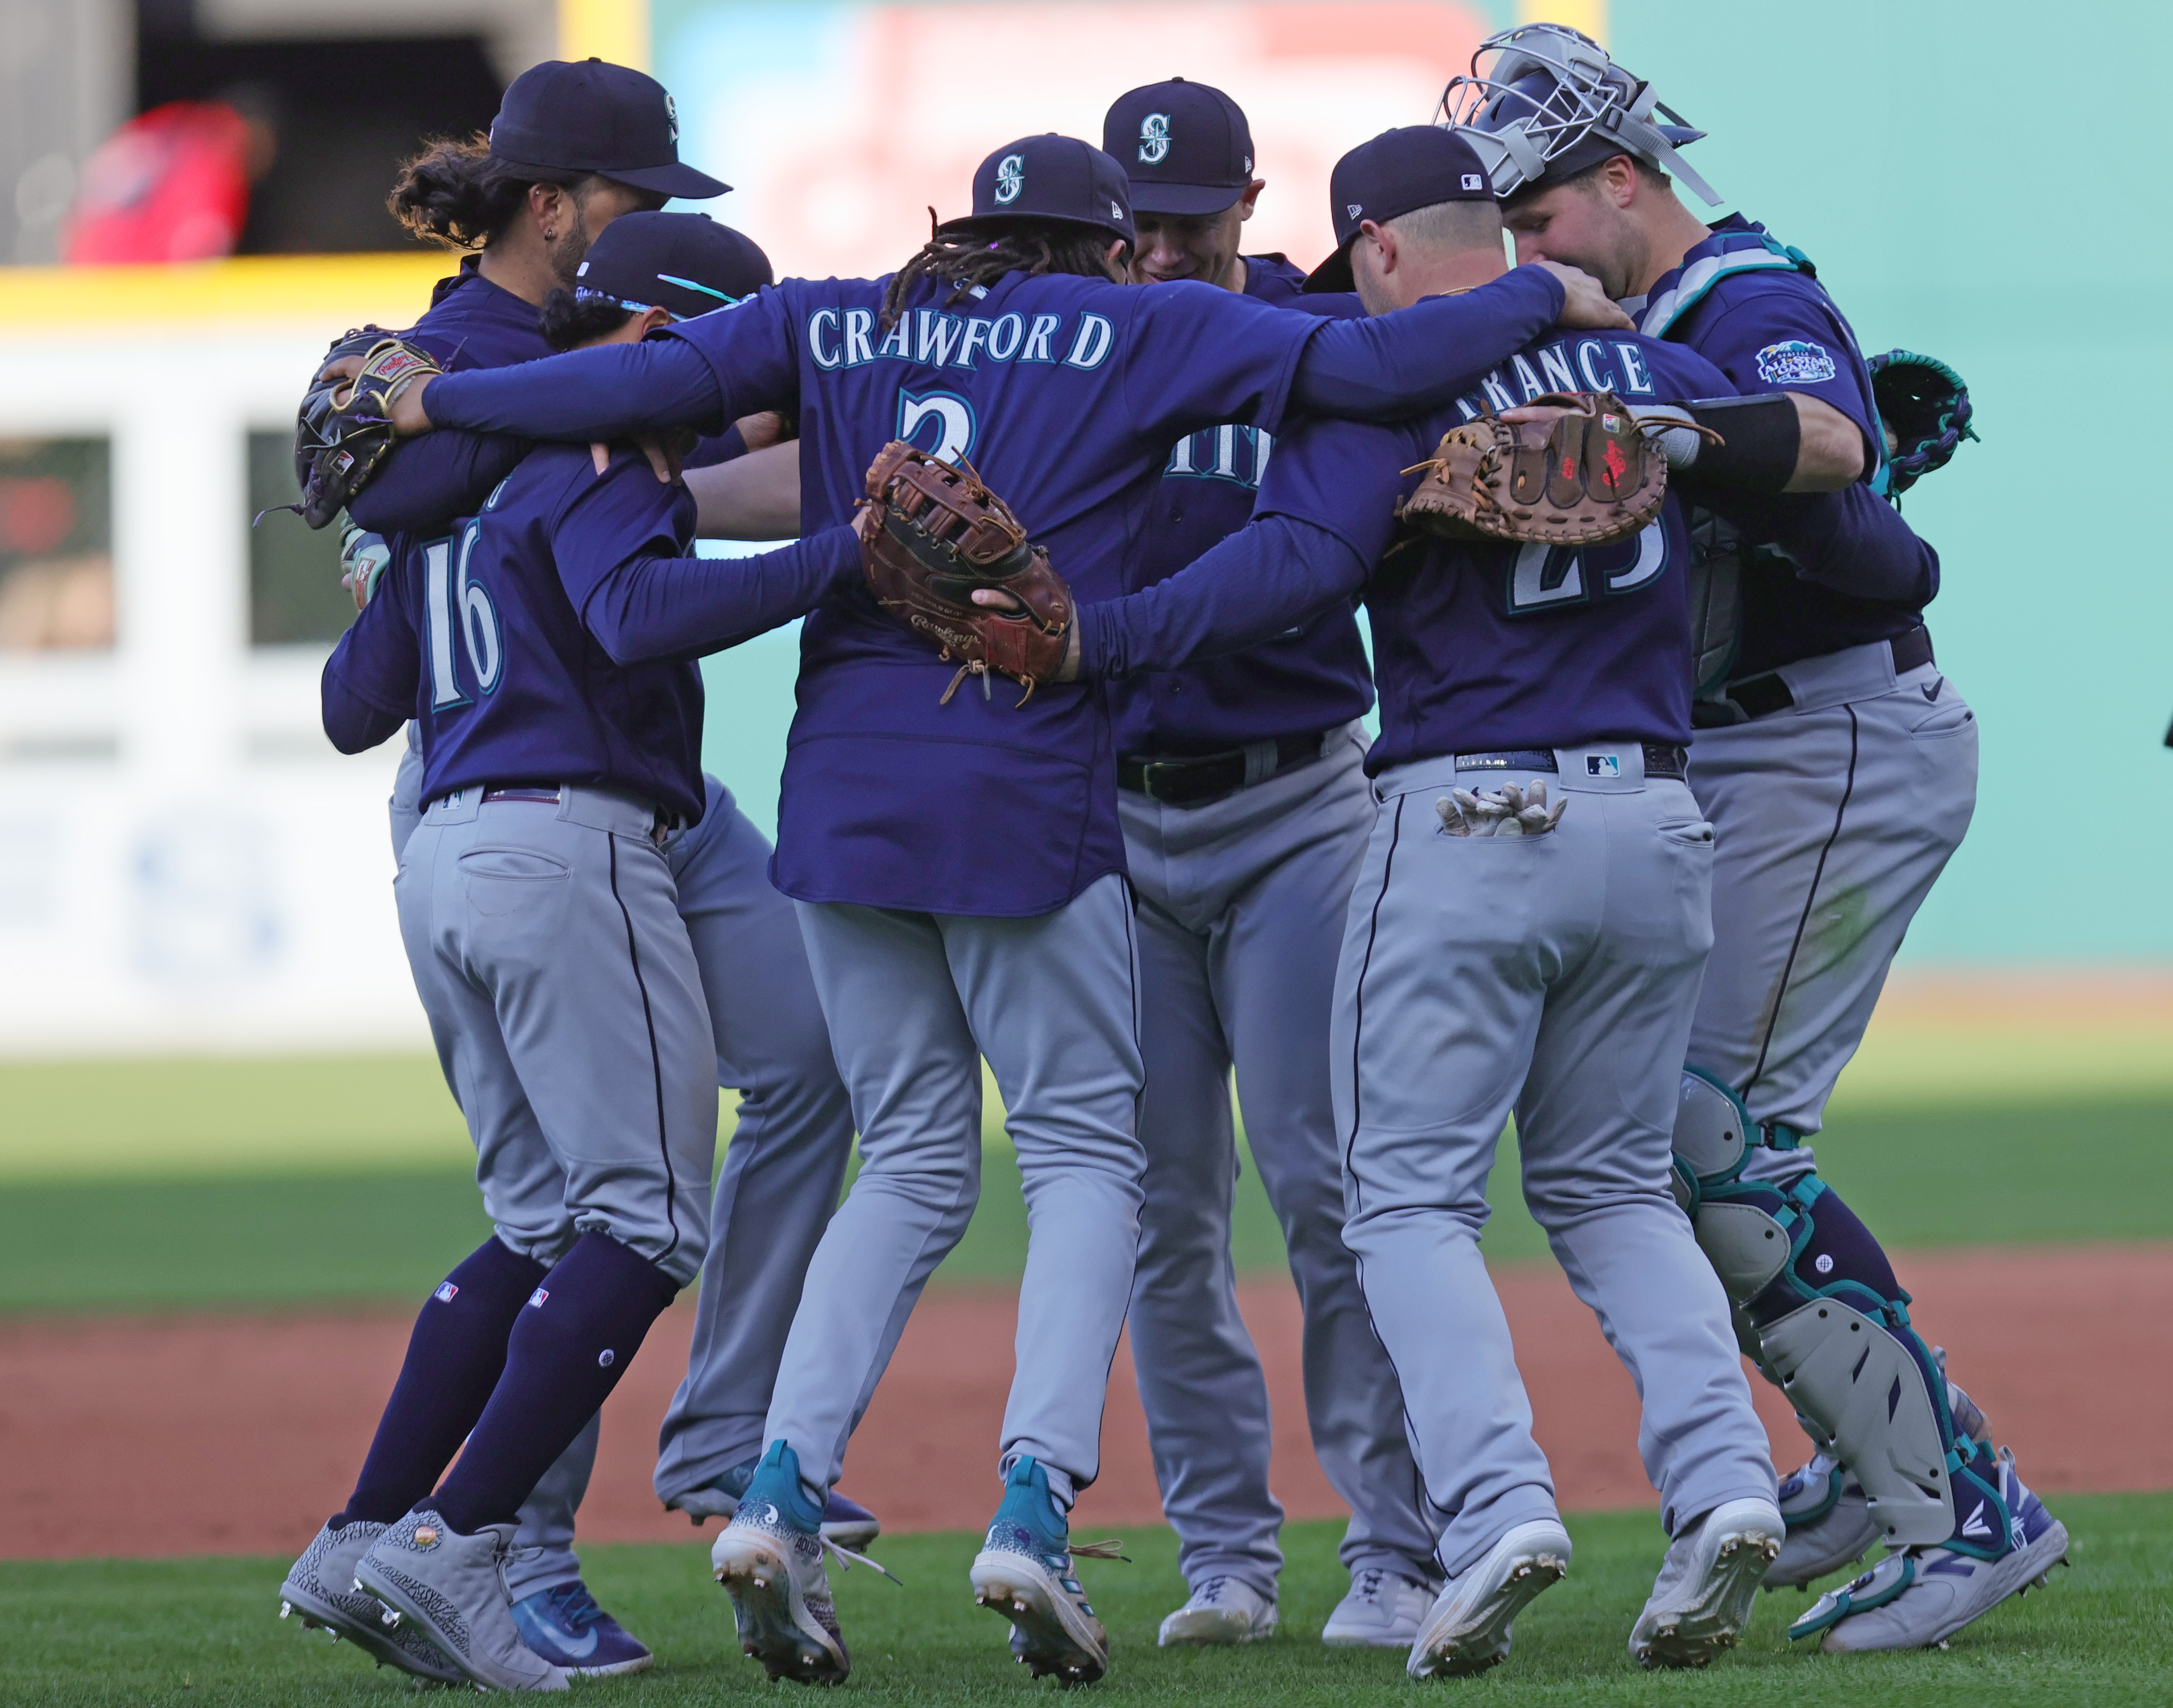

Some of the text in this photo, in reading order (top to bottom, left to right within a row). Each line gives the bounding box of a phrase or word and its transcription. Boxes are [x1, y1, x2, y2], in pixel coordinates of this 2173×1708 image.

[1138, 112, 1173, 164] S
[994, 154, 1025, 205] S
[807, 307, 1115, 370] CRAWFORD
[1777, 363, 1821, 375] GAME
[421, 517, 503, 714] 16
